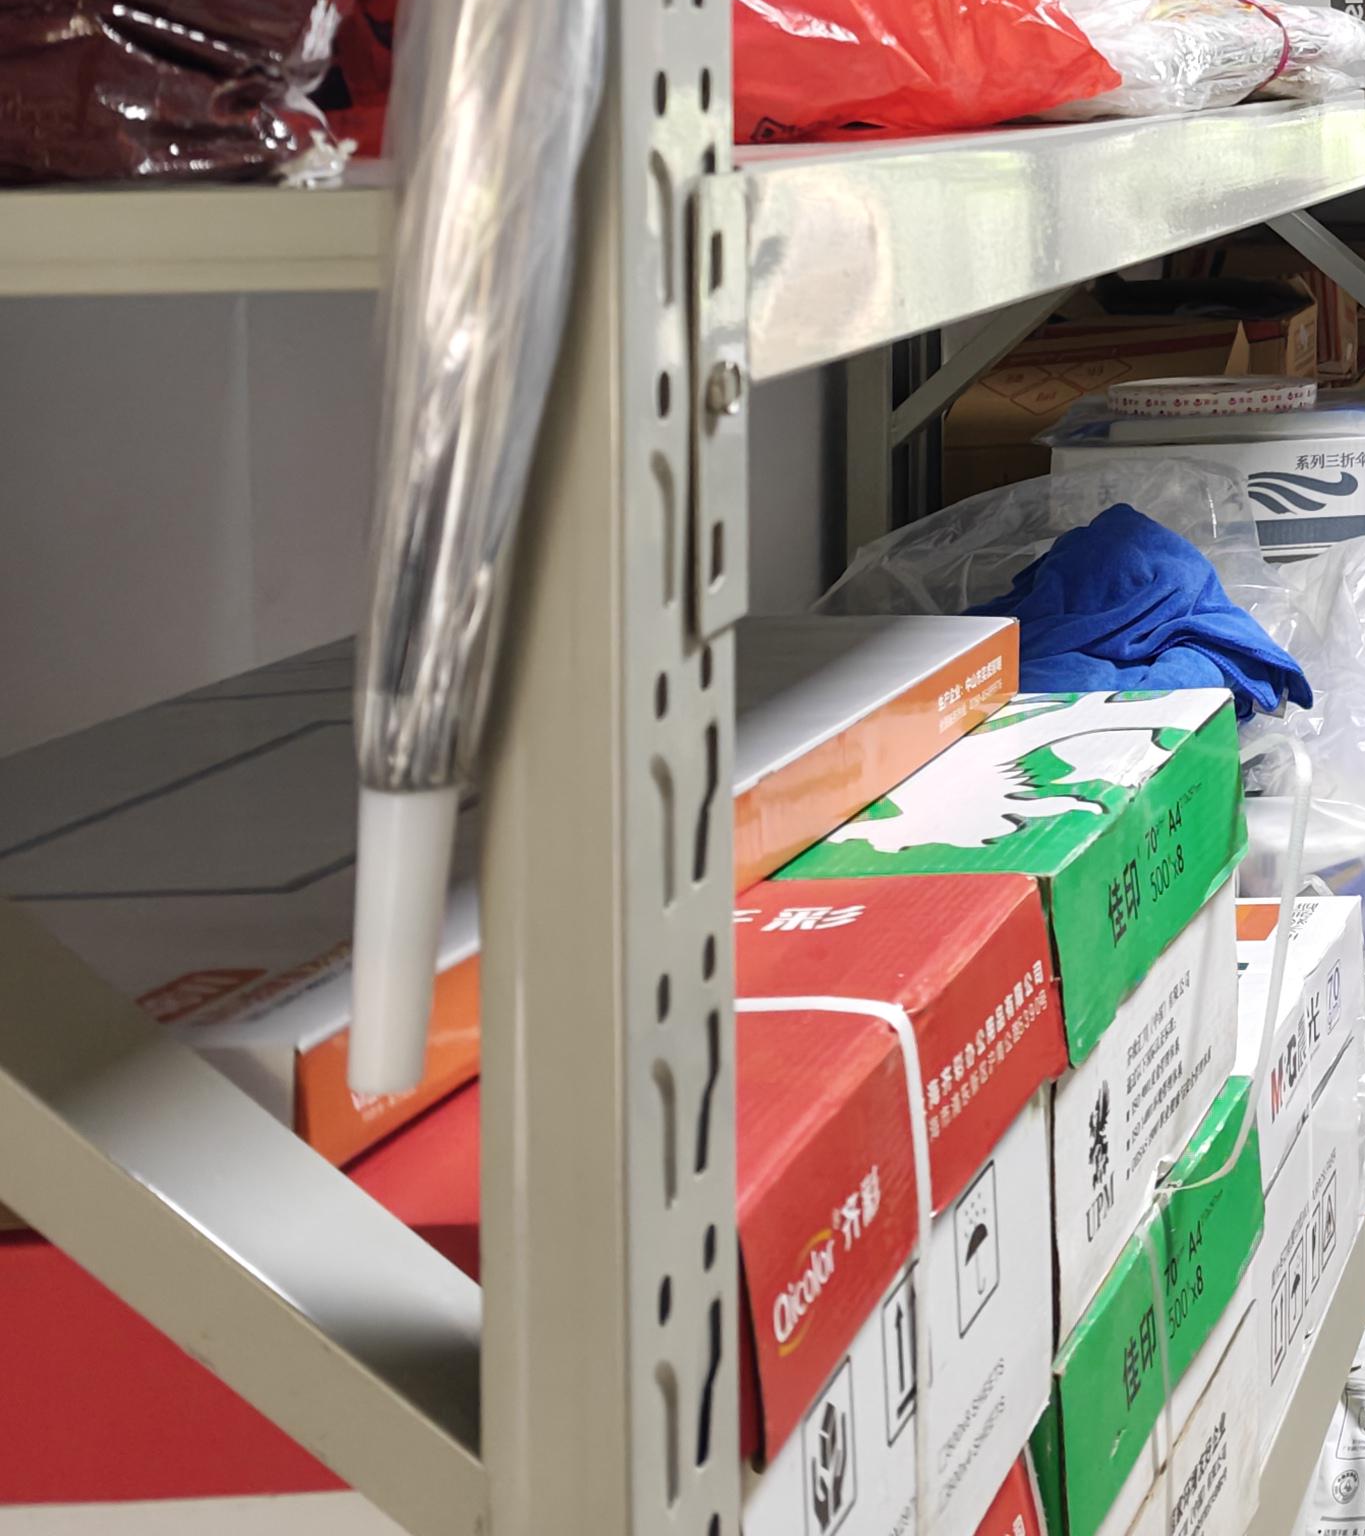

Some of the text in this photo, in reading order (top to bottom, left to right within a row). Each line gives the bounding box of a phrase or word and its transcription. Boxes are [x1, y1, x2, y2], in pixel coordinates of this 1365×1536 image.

[1168, 801, 1182, 837] A4
[733, 904, 866, 932] 彩
[1108, 858, 1141, 948] 佳印
[1086, 1171, 1115, 1243] UPM
[1188, 1220, 1203, 1263] A4
[1123, 1304, 1157, 1412] 佳印
